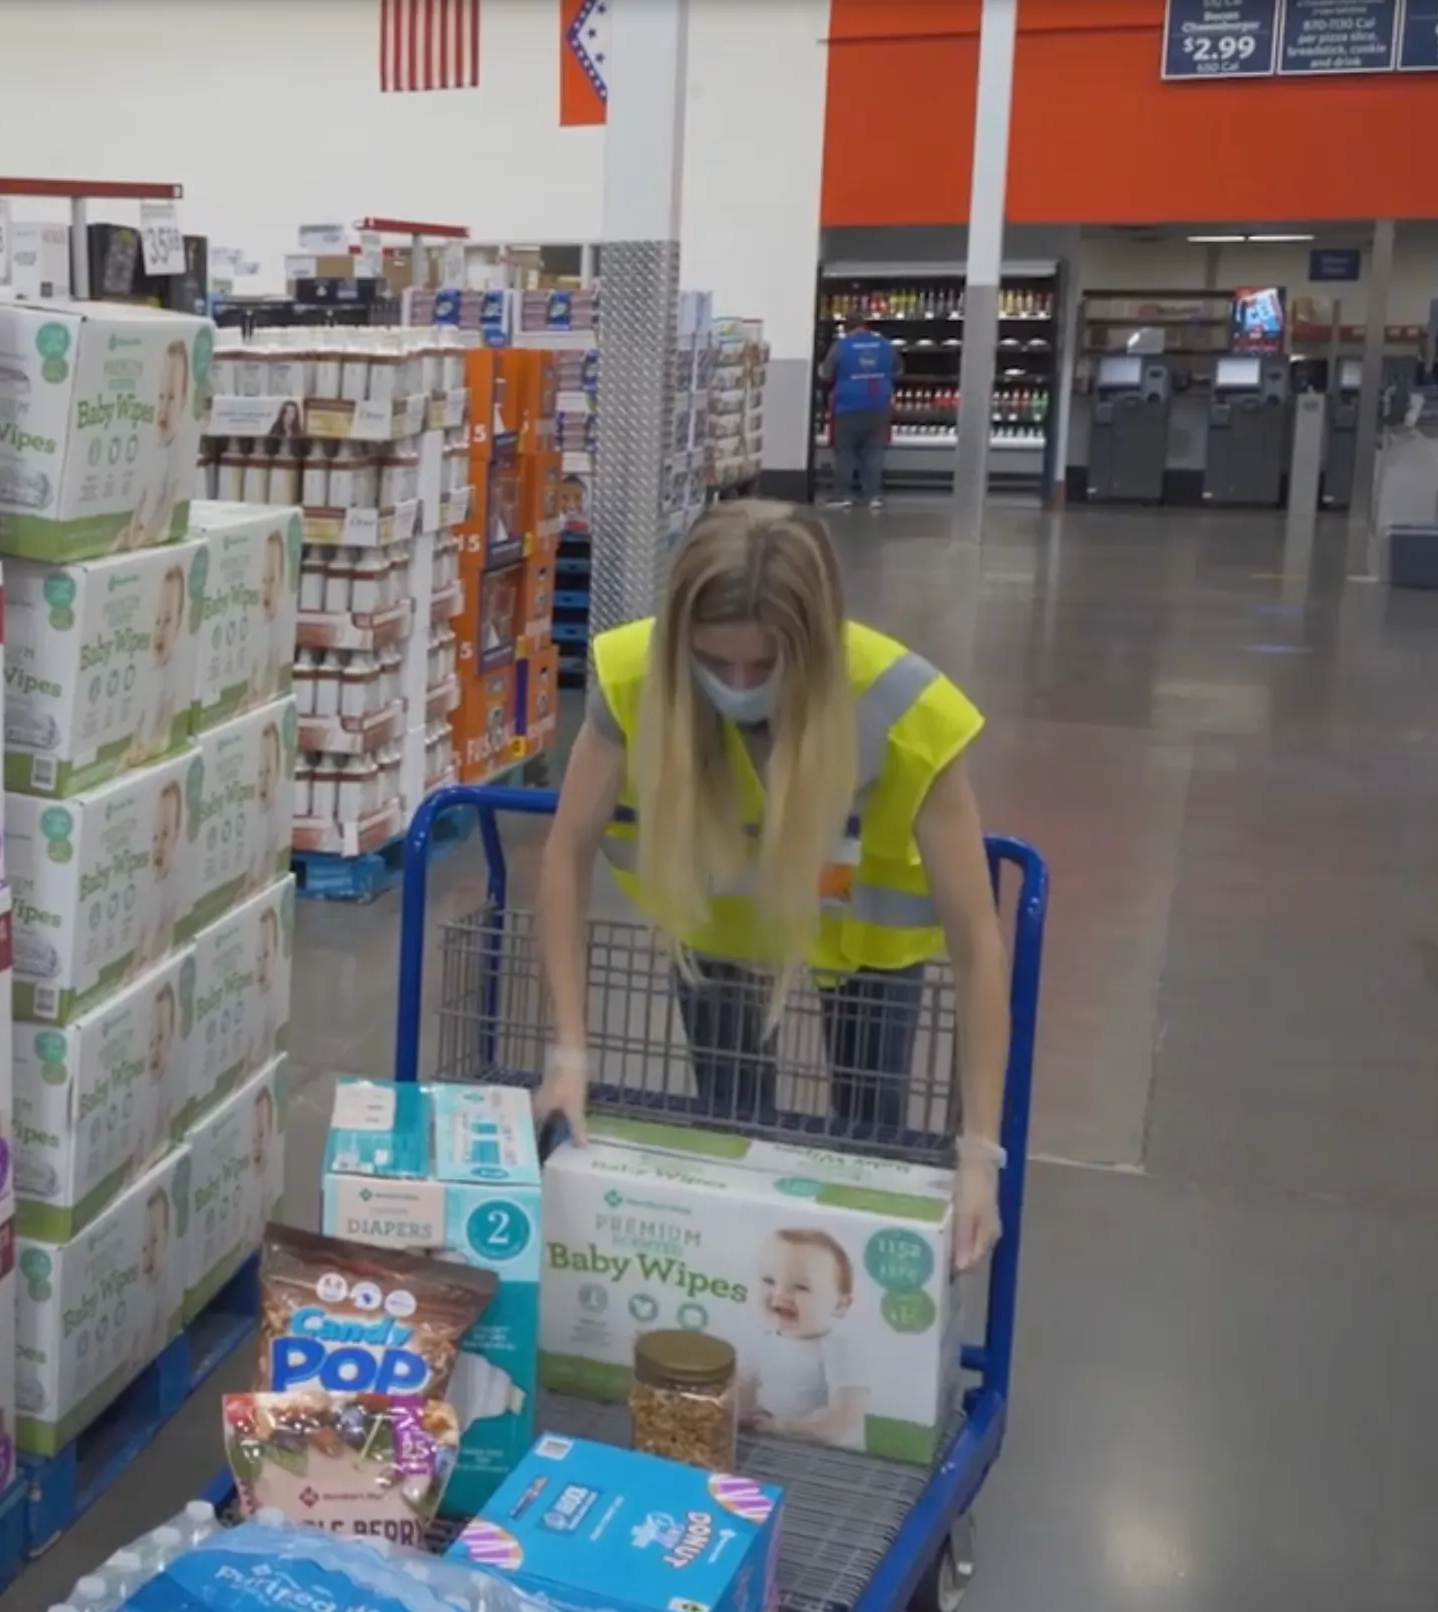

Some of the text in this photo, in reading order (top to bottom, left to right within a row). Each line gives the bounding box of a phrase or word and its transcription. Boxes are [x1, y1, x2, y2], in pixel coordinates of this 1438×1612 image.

[1182, 36, 1257, 61] $2.99
[473, 423, 486, 443] 5
[12, 896, 62, 928] ipes
[347, 1218, 433, 1239] DIAPERS
[487, 1209, 511, 1244] 2
[594, 1213, 703, 1247] PREMIUM
[547, 1241, 750, 1304] Baby Wipes
[289, 1305, 415, 1348] Candy
[270, 1335, 430, 1395] POP
[663, 1511, 711, 1569] DONUT
